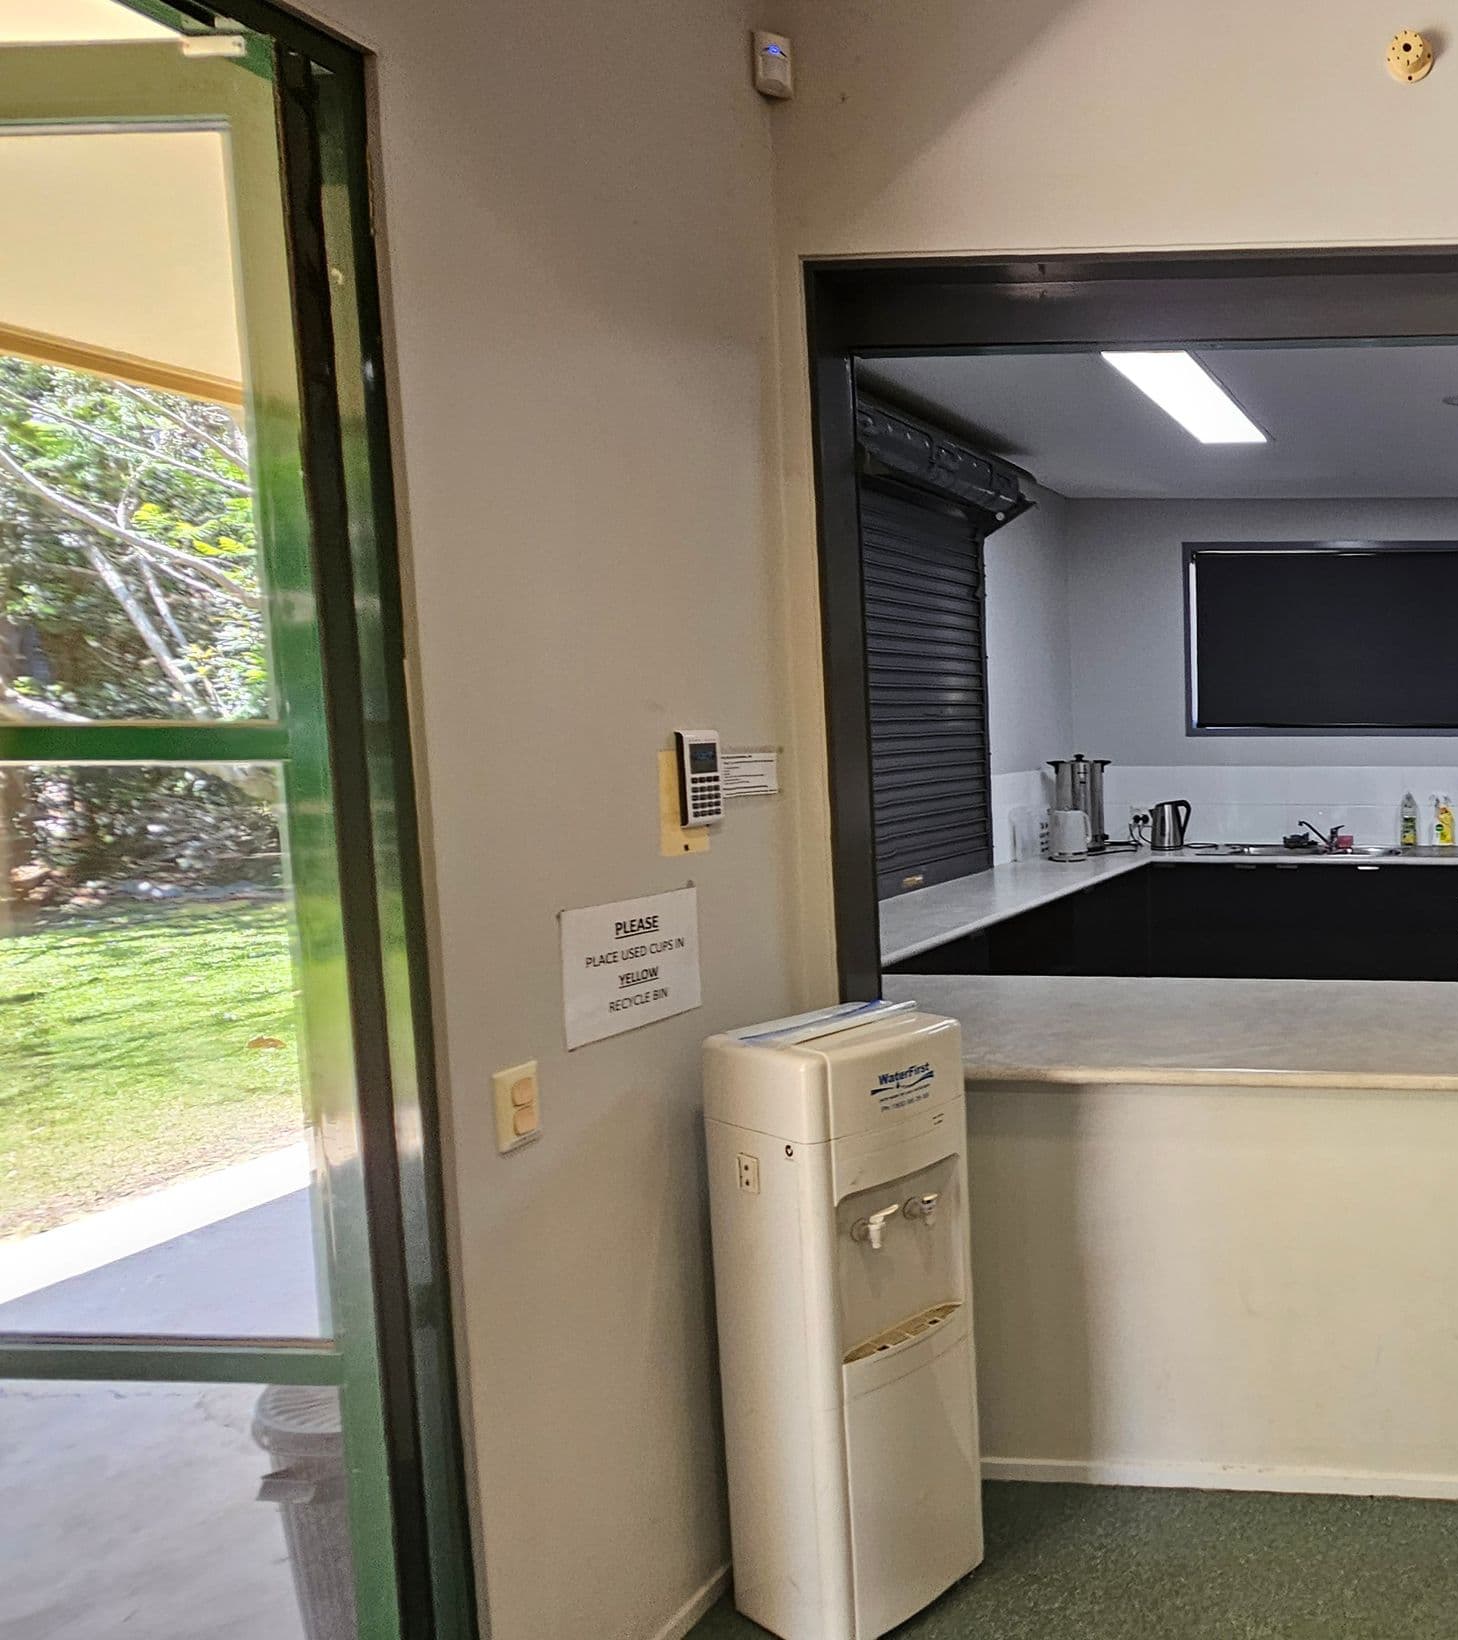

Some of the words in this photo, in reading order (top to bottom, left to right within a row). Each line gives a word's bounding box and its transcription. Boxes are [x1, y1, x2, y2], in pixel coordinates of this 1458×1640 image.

[614, 914, 660, 937] PLEASE
[585, 951, 618, 968] PLACE
[622, 945, 647, 961] USED
[649, 939, 674, 954] CUPS
[675, 937, 685, 948] IN
[618, 966, 660, 986] YELLOW
[609, 991, 650, 1013] RECYCLE
[652, 988, 668, 1001] BIN
[878, 1062, 931, 1086] WaterFirst
